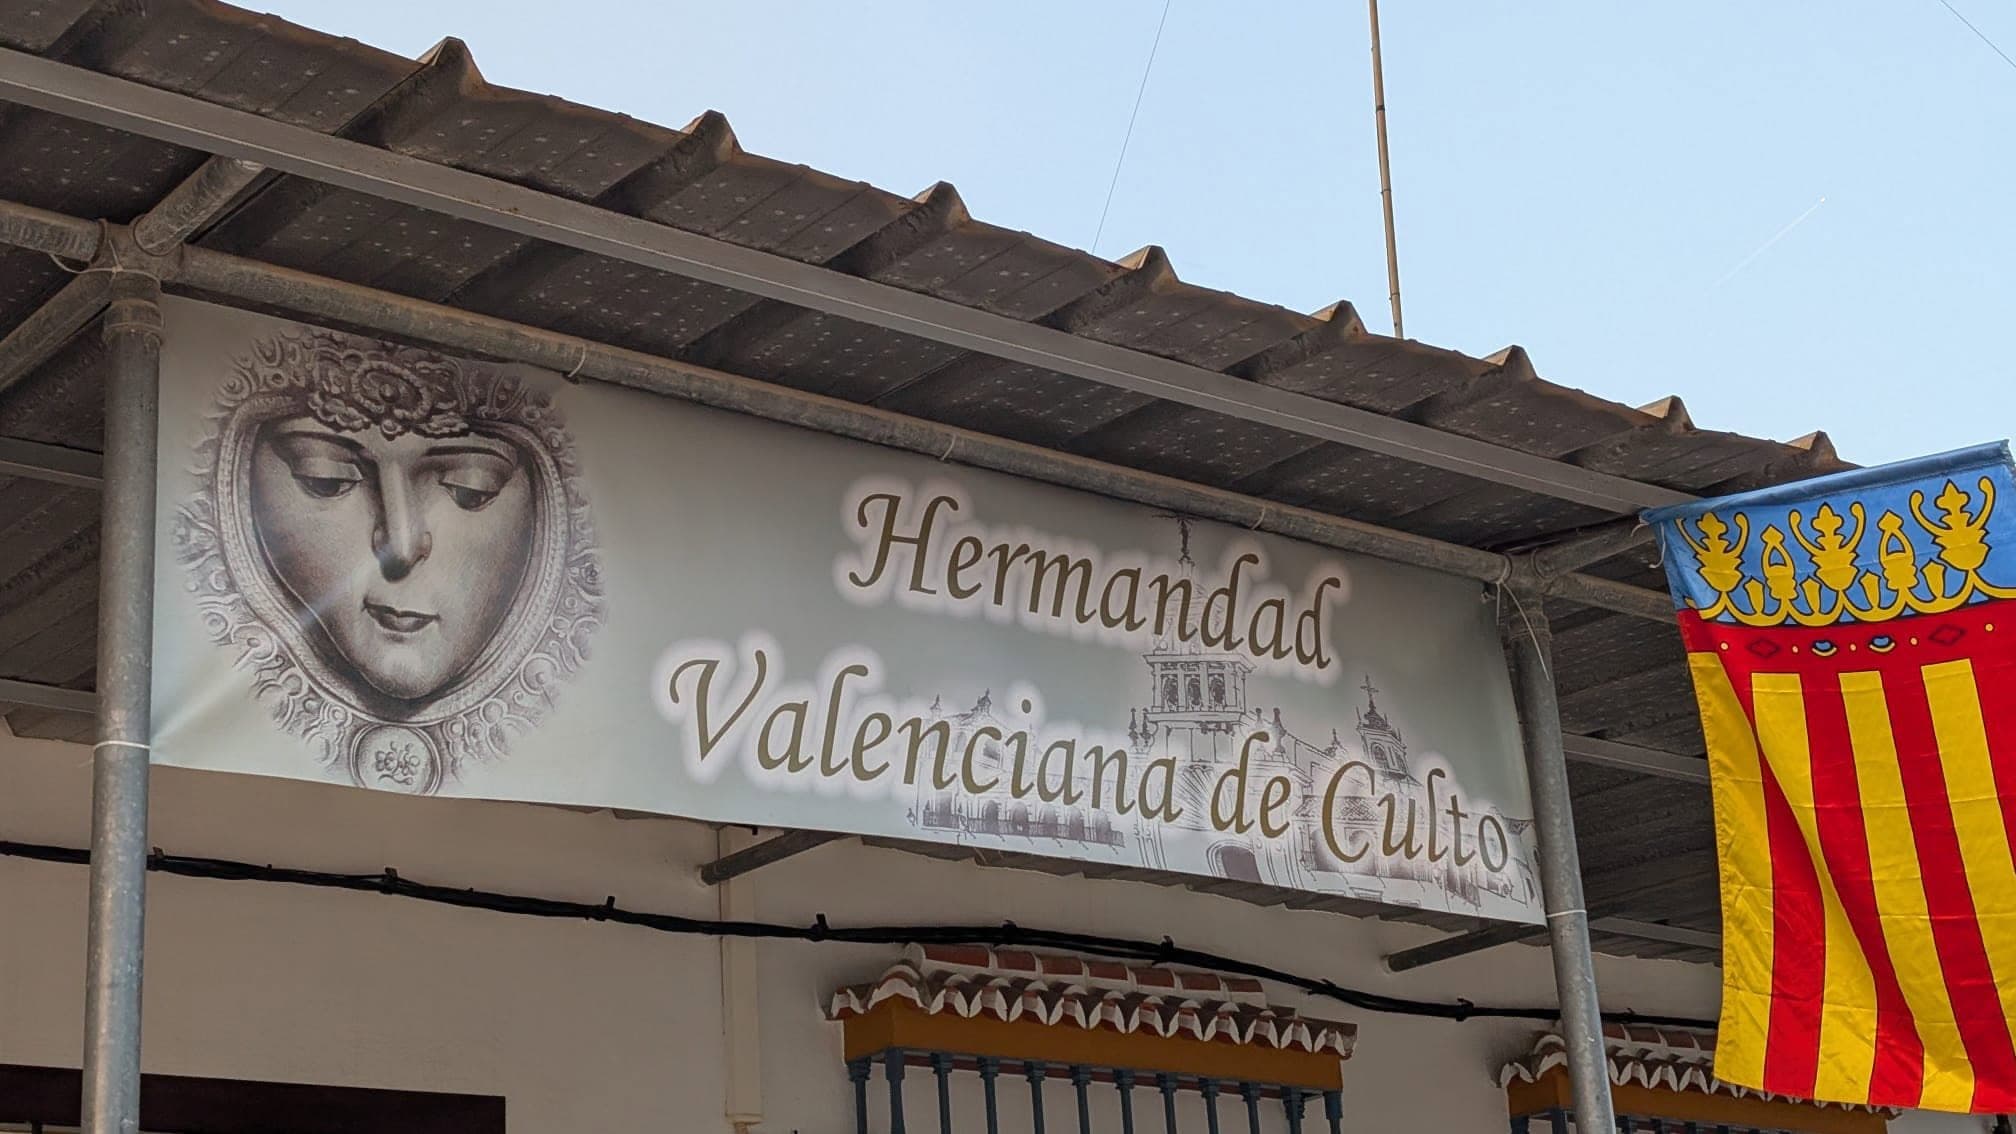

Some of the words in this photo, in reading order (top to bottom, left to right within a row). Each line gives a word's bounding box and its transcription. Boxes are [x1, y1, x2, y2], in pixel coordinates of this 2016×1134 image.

[848, 493, 1341, 669] Hermandad
[669, 649, 1183, 823] Valenciana
[1210, 731, 1291, 838] de
[1321, 760, 1509, 873] Culto
